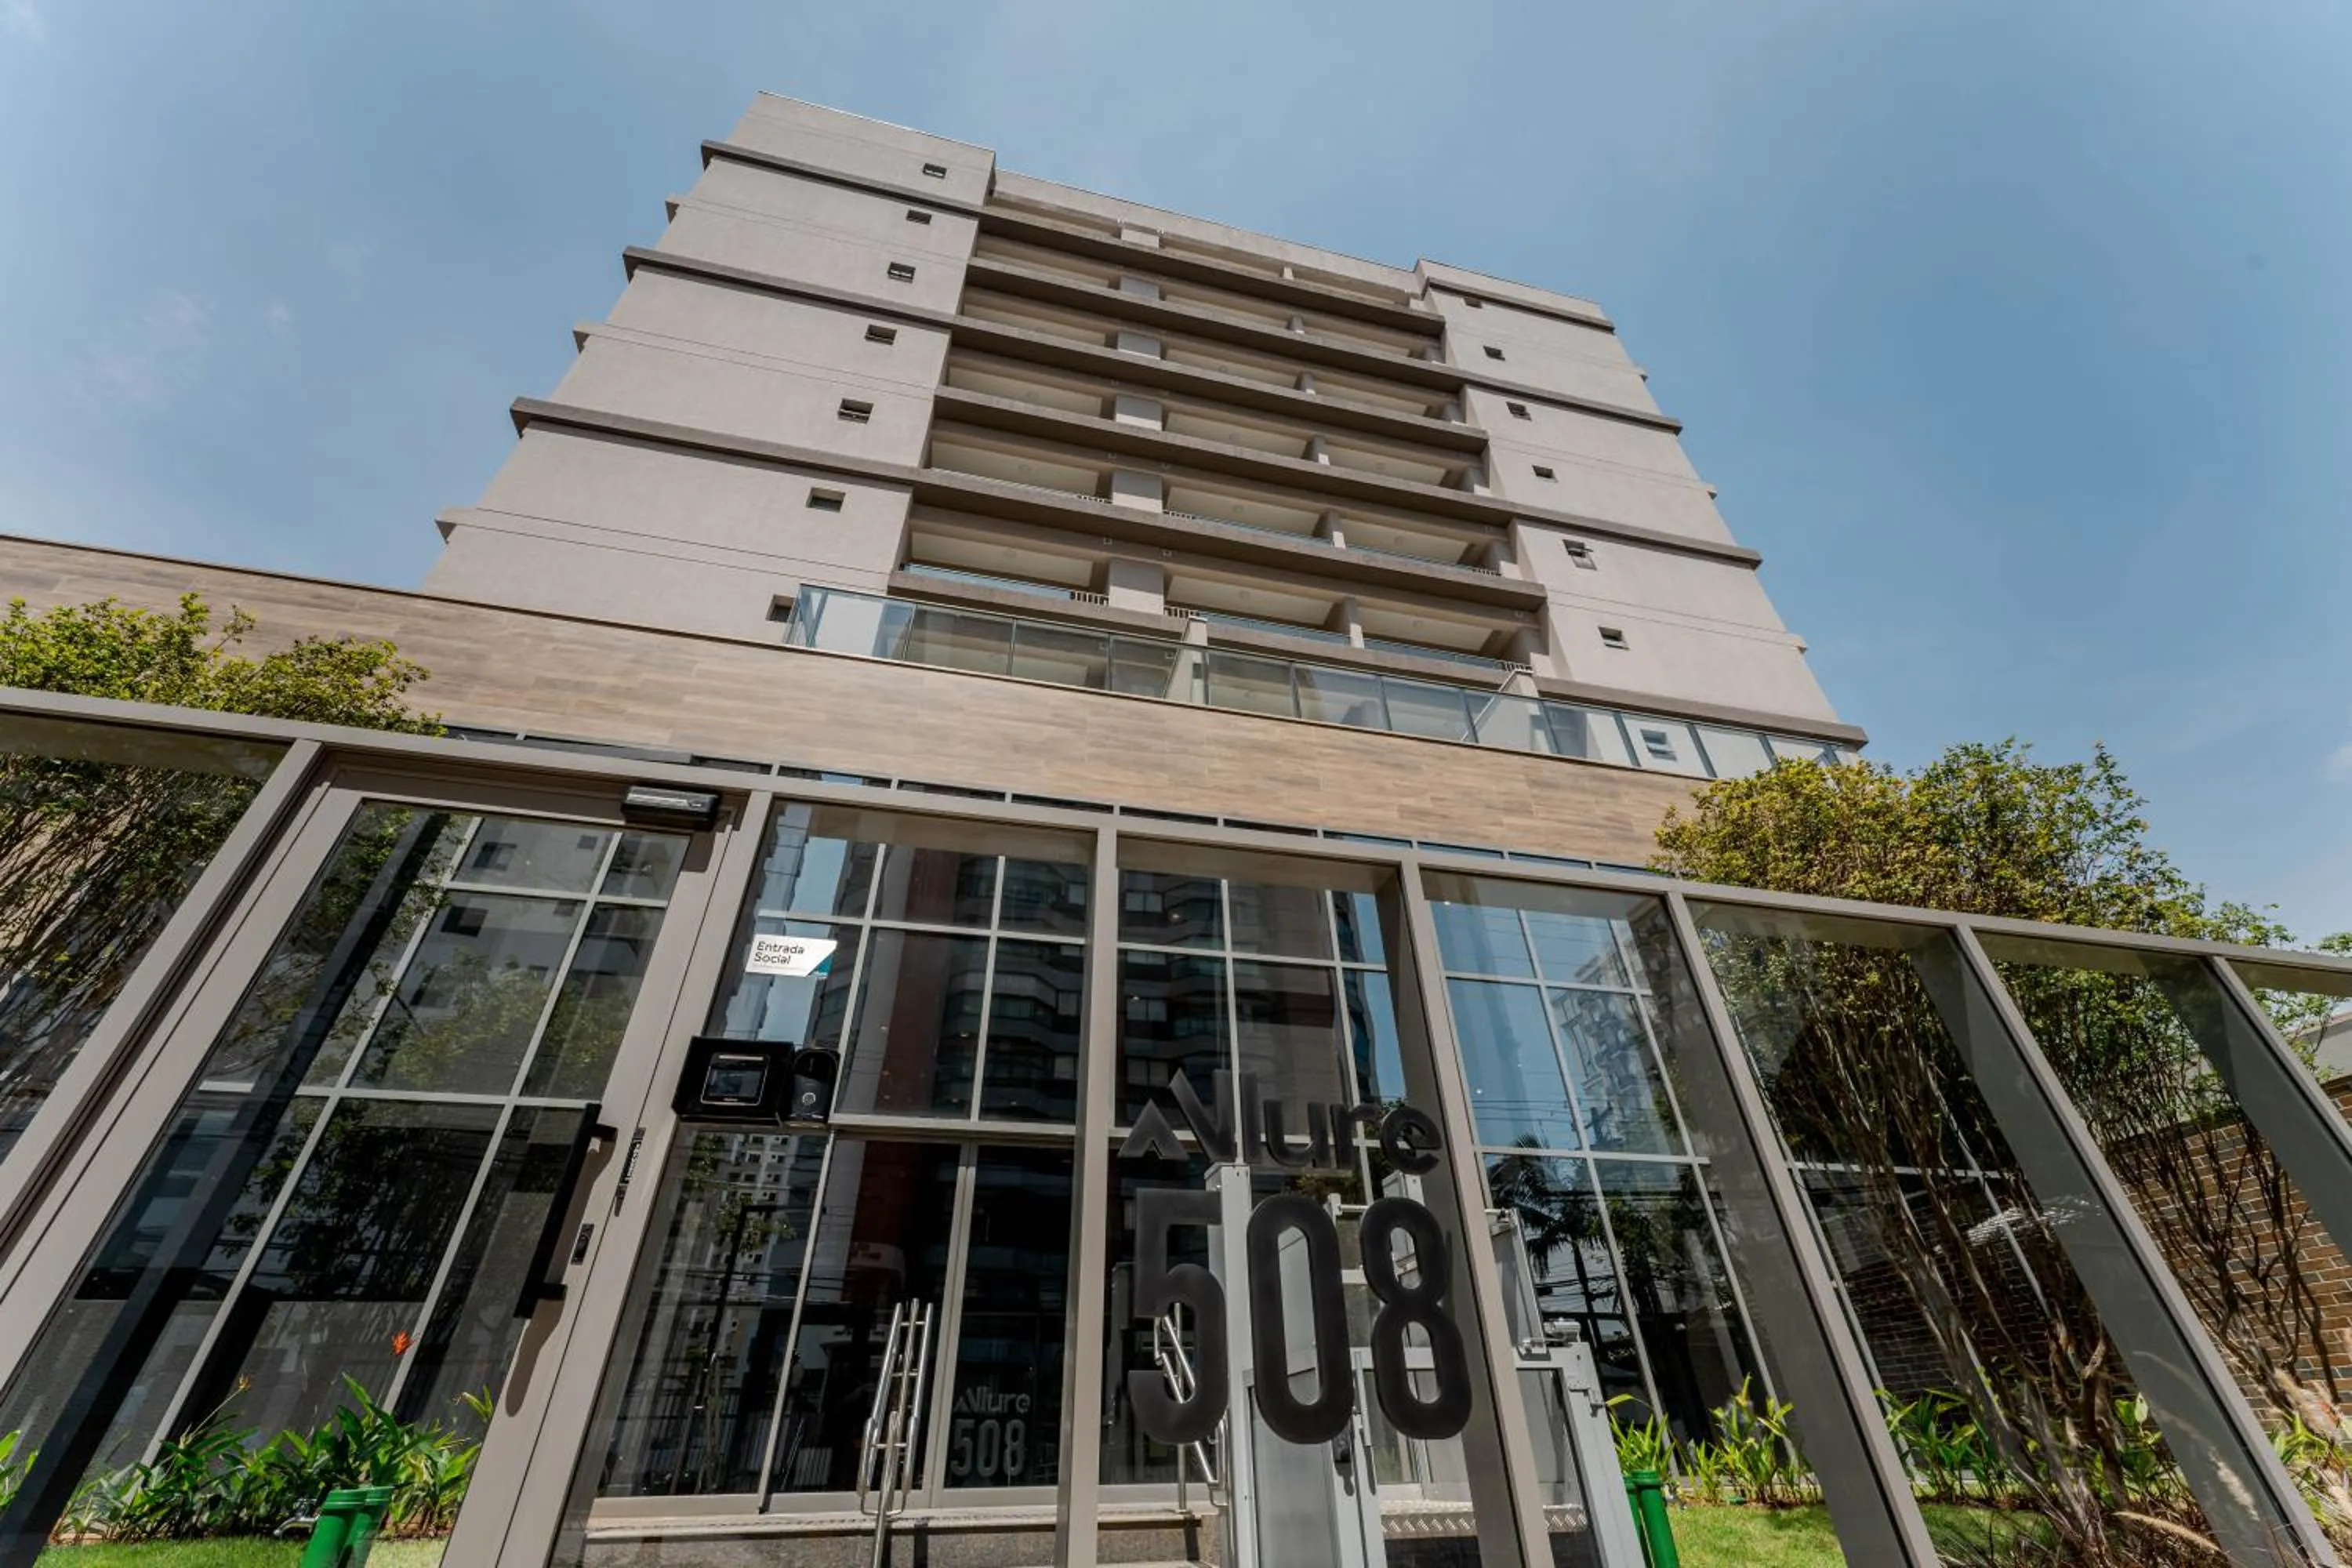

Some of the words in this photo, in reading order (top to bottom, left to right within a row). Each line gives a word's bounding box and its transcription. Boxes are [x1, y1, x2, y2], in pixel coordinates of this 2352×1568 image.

[754, 953, 791, 964] Social
[757, 941, 804, 954] Entrada
[1117, 1068, 1443, 1174] Allure
[1128, 1189, 1472, 1444] 508
[951, 1419, 1025, 1476] 508
